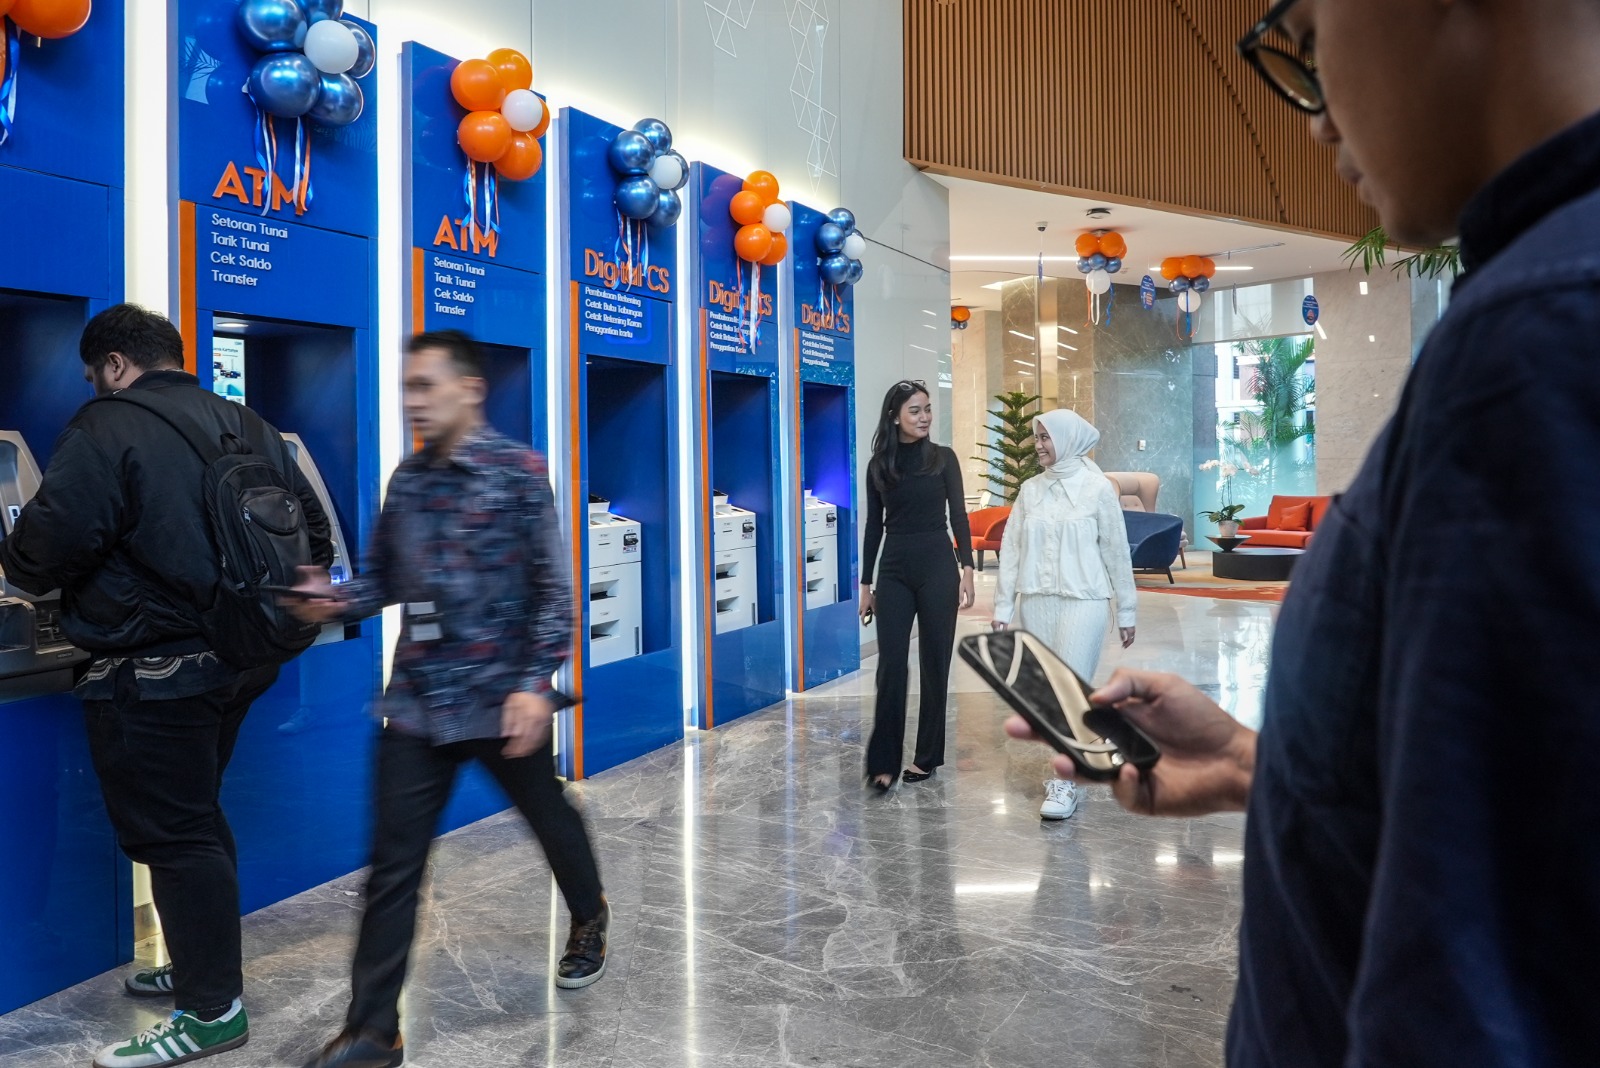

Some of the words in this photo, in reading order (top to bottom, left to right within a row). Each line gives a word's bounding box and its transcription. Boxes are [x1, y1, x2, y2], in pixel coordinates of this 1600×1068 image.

[212, 161, 304, 216] ATM
[211, 213, 257, 233] Setoran
[259, 222, 289, 239] Tunai
[433, 214, 496, 258] ATM
[211, 231, 238, 248] Tarik
[240, 236, 270, 253] Tunai
[210, 251, 236, 265] Cek
[239, 254, 272, 271] Saldo
[434, 256, 464, 272] Setoran
[464, 263, 485, 276] Tunai
[211, 269, 259, 287] Transfer
[434, 272, 453, 285] Tarik
[455, 276, 476, 289] Tunai
[647, 265, 670, 293] CS
[434, 287, 451, 300] Cek
[452, 290, 474, 303] Saldo
[434, 302, 466, 316] Transfer
